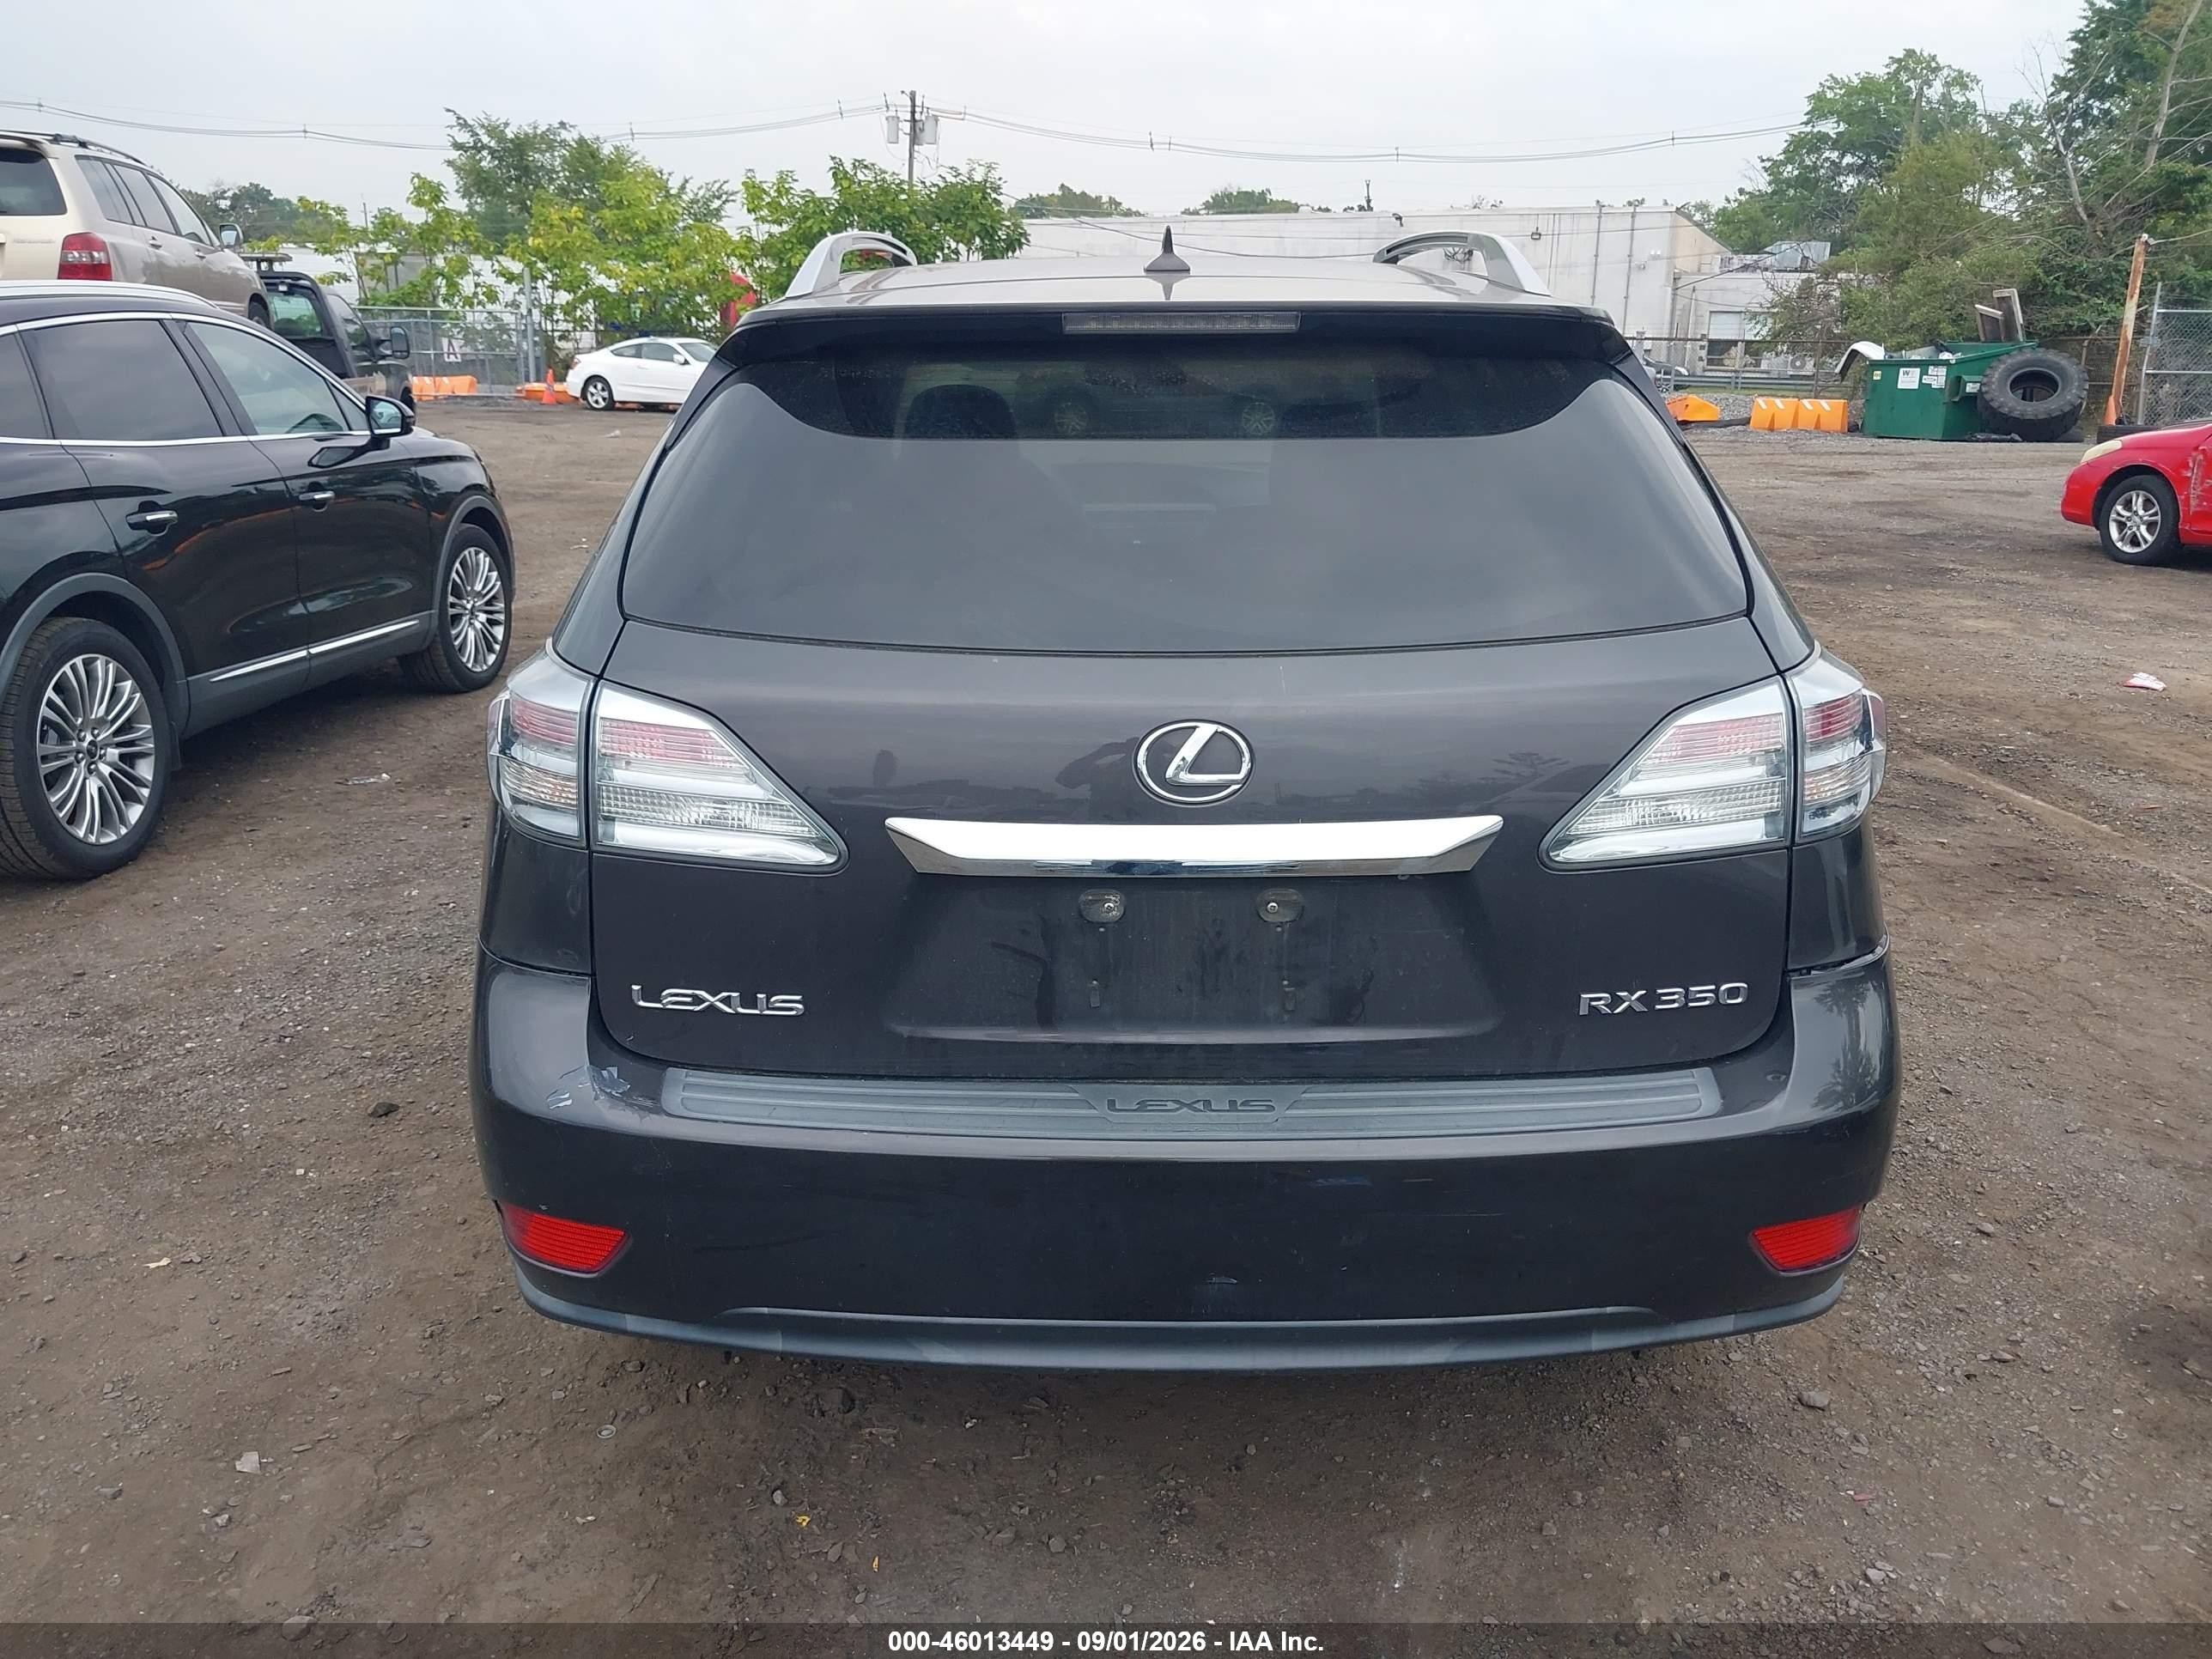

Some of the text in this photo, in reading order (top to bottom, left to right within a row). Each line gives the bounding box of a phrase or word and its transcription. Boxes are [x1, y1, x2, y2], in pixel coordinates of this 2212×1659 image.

[630, 985, 805, 1016] LEXUS
[1578, 982, 1748, 1016] RX 350
[1107, 1098, 1276, 1114] LEXUS
